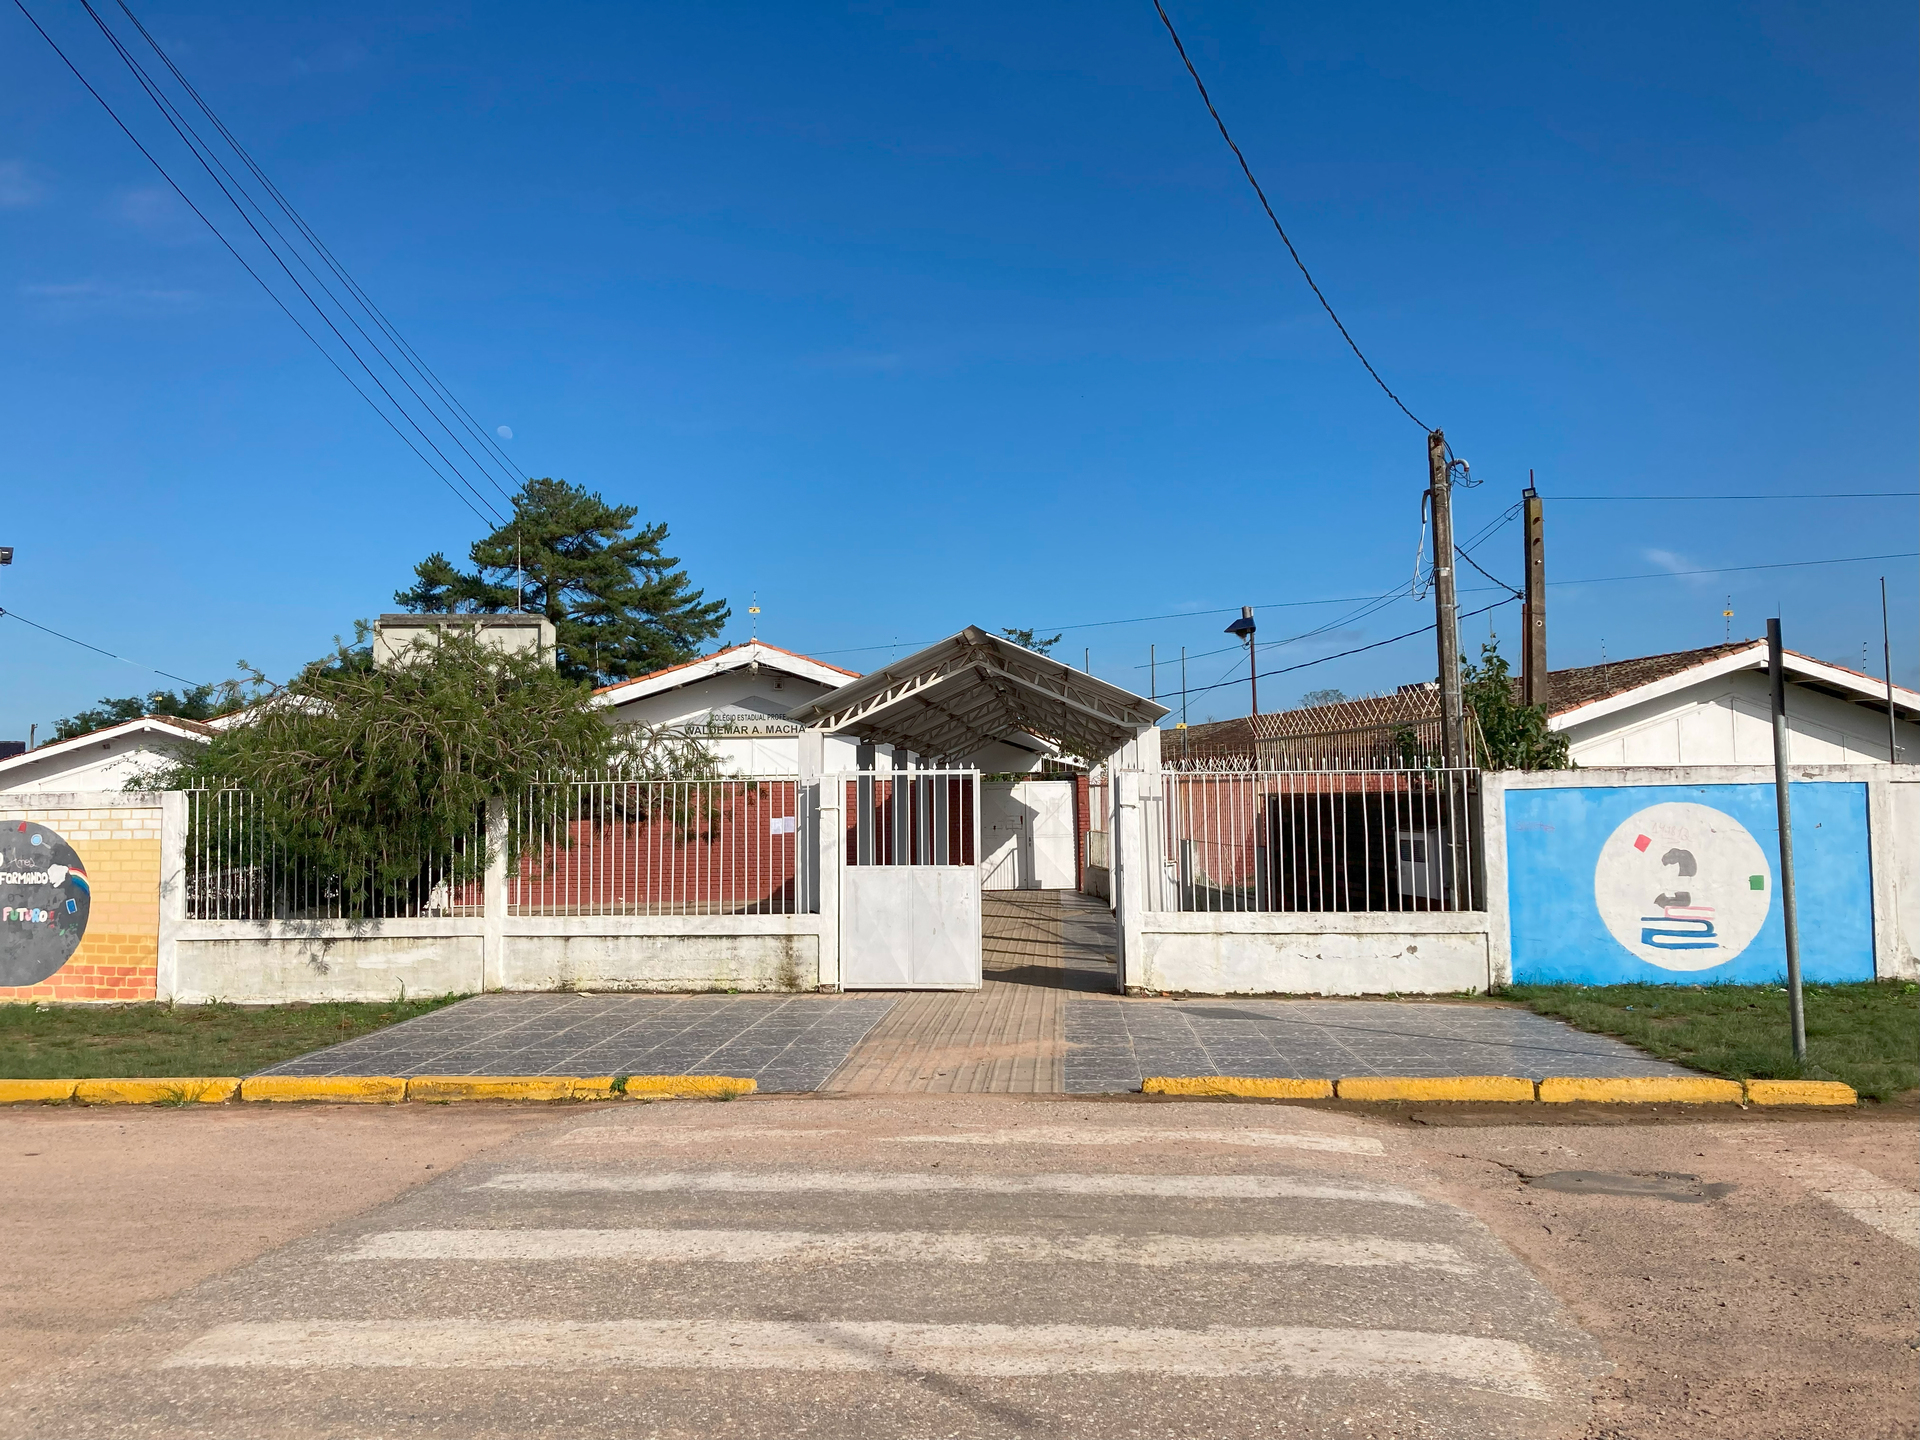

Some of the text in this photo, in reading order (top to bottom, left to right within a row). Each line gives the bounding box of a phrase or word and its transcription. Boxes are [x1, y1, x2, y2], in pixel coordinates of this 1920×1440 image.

[737, 713, 766, 721] ESTADUAL
[684, 724, 806, 735] WALDEMAR A. MACHA
